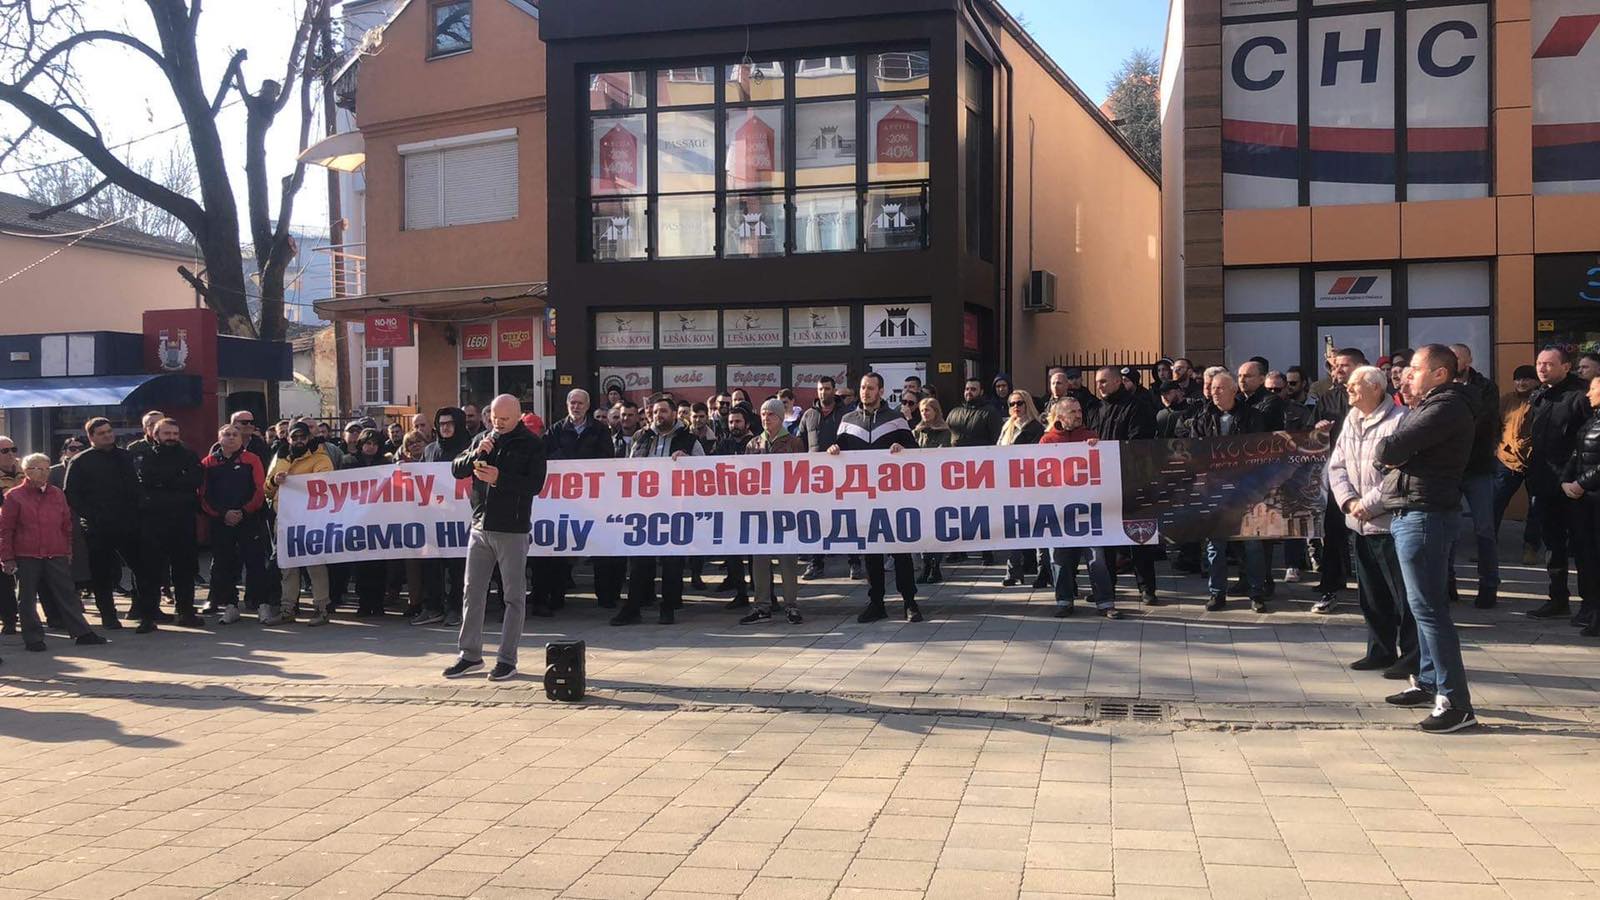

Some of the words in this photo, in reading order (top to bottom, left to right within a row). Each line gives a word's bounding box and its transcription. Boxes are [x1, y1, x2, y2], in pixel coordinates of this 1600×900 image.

[466, 335, 489, 348] LEGO
[629, 334, 650, 344] KOM
[663, 331, 691, 344] LEŠAK
[693, 334, 714, 344] KOM
[727, 331, 757, 343] LEŠAK
[758, 333, 780, 342] KOM
[793, 329, 822, 341] LEŠAK
[824, 331, 848, 340] KOM
[673, 370, 704, 383] vaše
[307, 470, 444, 513] Вучићу,
[617, 471, 660, 498] те
[672, 461, 772, 496] неће!
[941, 460, 995, 491] си
[1009, 449, 1101, 488] нас!
[287, 522, 426, 557] Нећемо
[740, 507, 921, 550] ПРОДАО
[935, 505, 990, 542] СИ
[1003, 503, 1102, 539] НАС!
